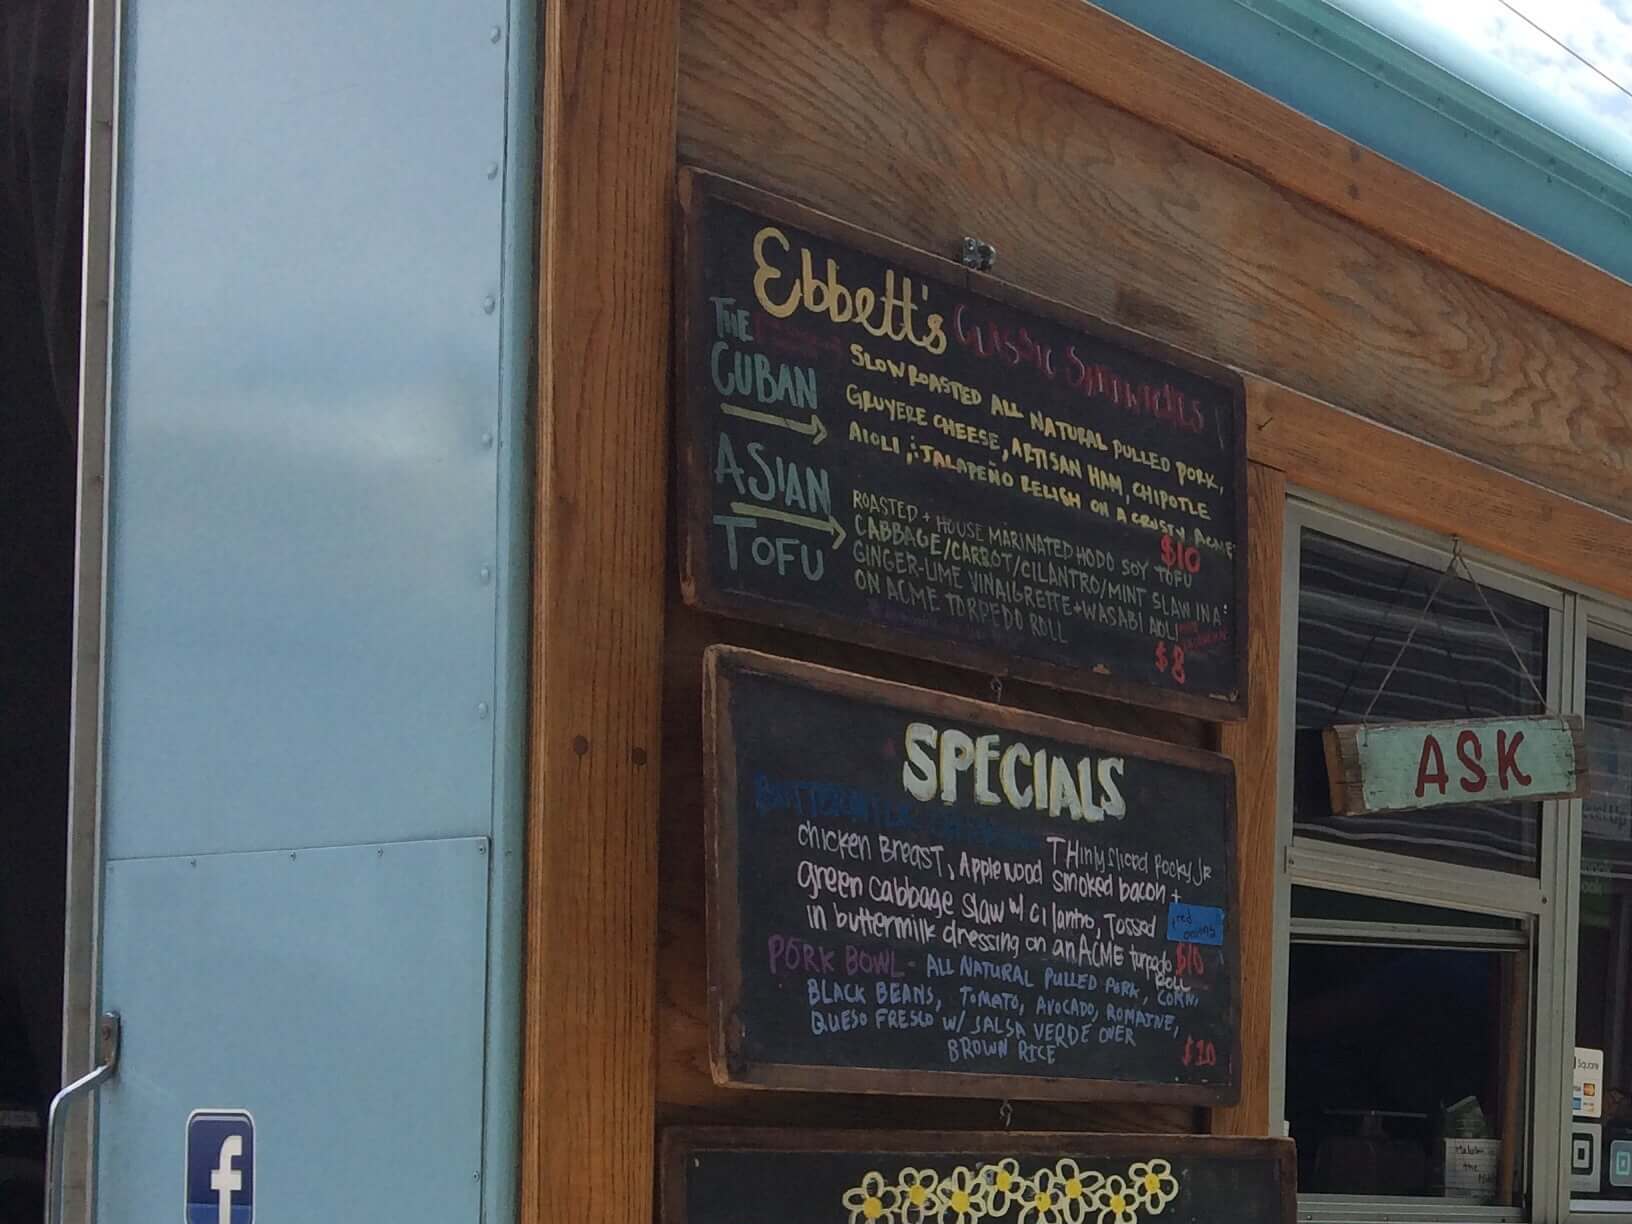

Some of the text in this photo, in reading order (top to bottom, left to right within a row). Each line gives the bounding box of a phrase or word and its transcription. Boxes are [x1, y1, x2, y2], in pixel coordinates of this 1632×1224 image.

[709, 296, 753, 341] THE
[753, 226, 947, 354] Ebbett's
[711, 341, 817, 409] CUBAN
[846, 384, 928, 427] GRUYERE
[1012, 437, 1082, 479] ARTISAN
[1132, 481, 1211, 520] CHIPOTLE
[991, 394, 1024, 419] ALL
[1029, 410, 1108, 452] NATURAL
[1112, 439, 1170, 473] PULLED
[714, 432, 831, 515] ASIAN
[849, 422, 900, 454] AIOLI
[1020, 475, 1081, 509] RELISH
[1090, 500, 1109, 517] ON
[1116, 507, 1127, 523] A
[1131, 513, 1185, 541] CRUSTY
[713, 515, 825, 582] TOFU
[853, 489, 1193, 589] ROASTED HOUSE MARINATED HODO SOY TOFU
[853, 540, 963, 590] GINGER-LIME
[1160, 535, 1200, 575] $10
[854, 569, 880, 594] ON
[886, 576, 940, 613] ACME
[945, 592, 1024, 631] TORPEDO
[1030, 613, 1070, 644] ROLL
[1152, 592, 1190, 620] SLAW
[1154, 640, 1186, 685] $8
[903, 722, 1126, 822] SPECIALS
[1415, 730, 1531, 797] ASK
[1119, 876, 1167, 905] bacon
[834, 902, 937, 944] buttermilk
[942, 920, 1020, 959] dressing
[1026, 935, 1046, 952] on
[1052, 940, 1075, 962] an
[1079, 935, 1124, 968] ACME
[807, 978, 866, 1007] BLACK
[927, 953, 954, 977] ALL
[960, 955, 1035, 988] NATURAL
[1044, 967, 1097, 990] PULLED
[811, 1008, 1136, 1049] QUESO FRESCO SALSA VERDE OVER
[949, 1037, 1056, 1065] BROWN RICE
